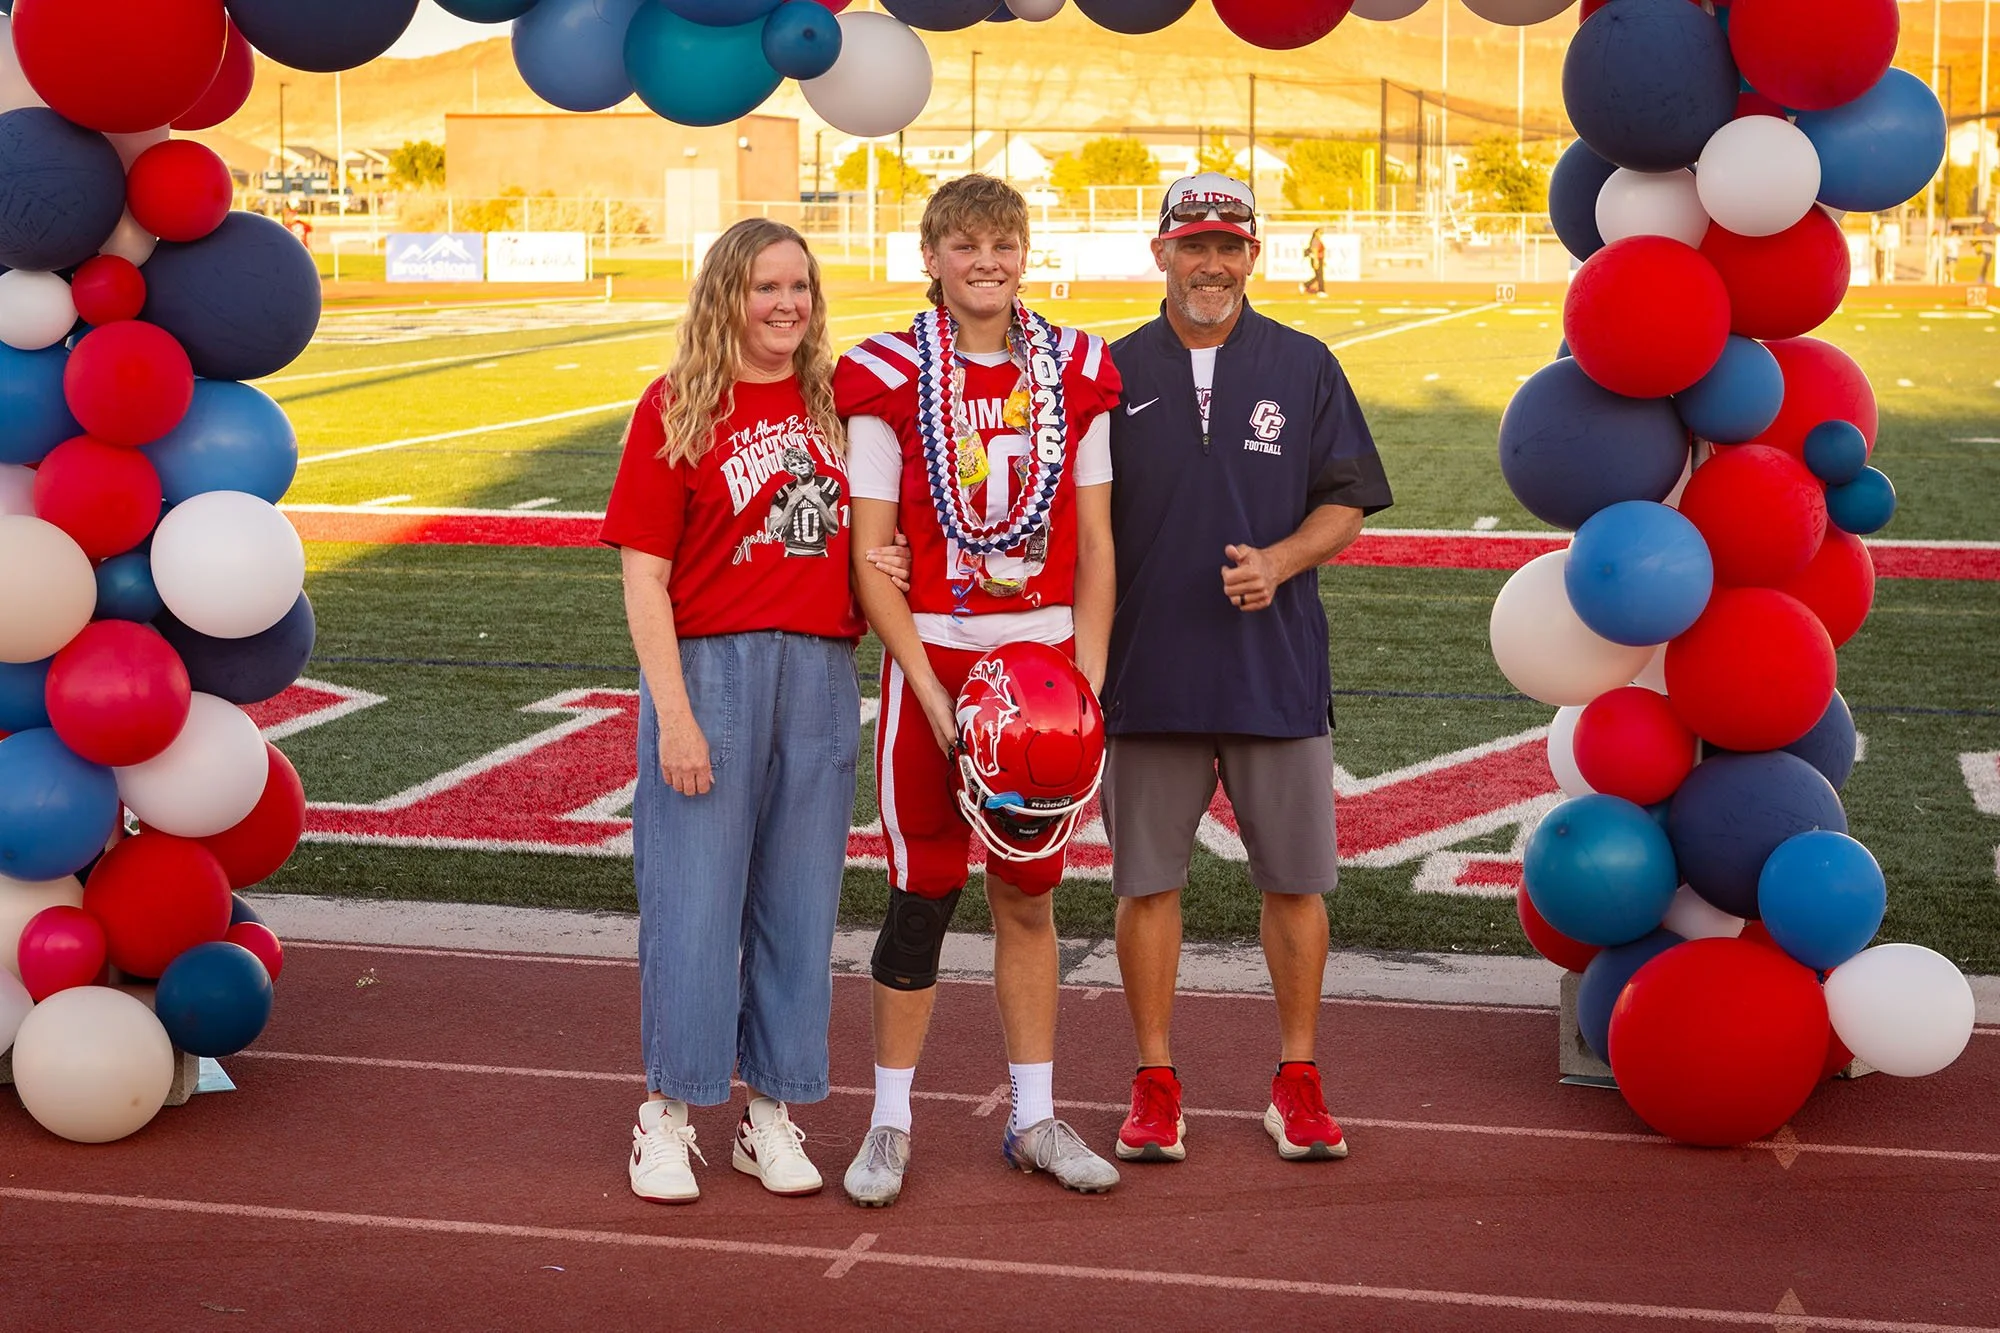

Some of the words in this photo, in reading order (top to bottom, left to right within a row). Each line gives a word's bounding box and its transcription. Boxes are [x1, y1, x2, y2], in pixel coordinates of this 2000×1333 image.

[1055, 284, 1064, 297] G
[1497, 286, 1514, 300] 10
[1026, 323, 1063, 464] 2026
[752, 418, 787, 439] Always
[786, 414, 804, 435] Be
[1249, 400, 1286, 442] CC
[1244, 439, 1282, 456] FOOTBALL
